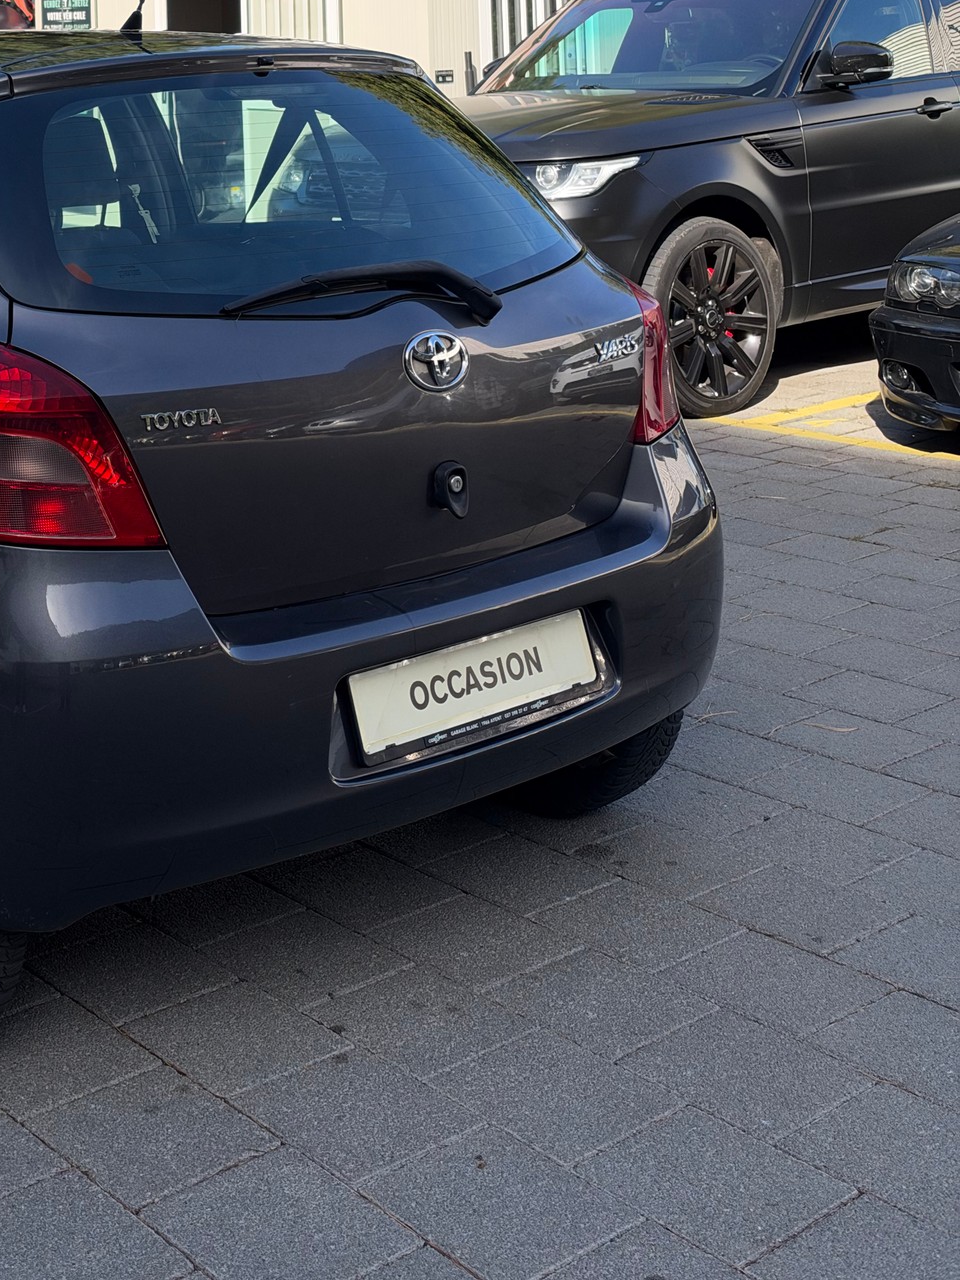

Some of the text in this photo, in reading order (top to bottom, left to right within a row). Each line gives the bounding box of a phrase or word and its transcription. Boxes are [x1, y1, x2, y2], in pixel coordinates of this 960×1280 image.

[62, 9, 86, 21] VÉHCULE
[594, 333, 639, 363] YARIS
[140, 408, 222, 432] TOYOTA
[409, 646, 543, 711] OCCASION
